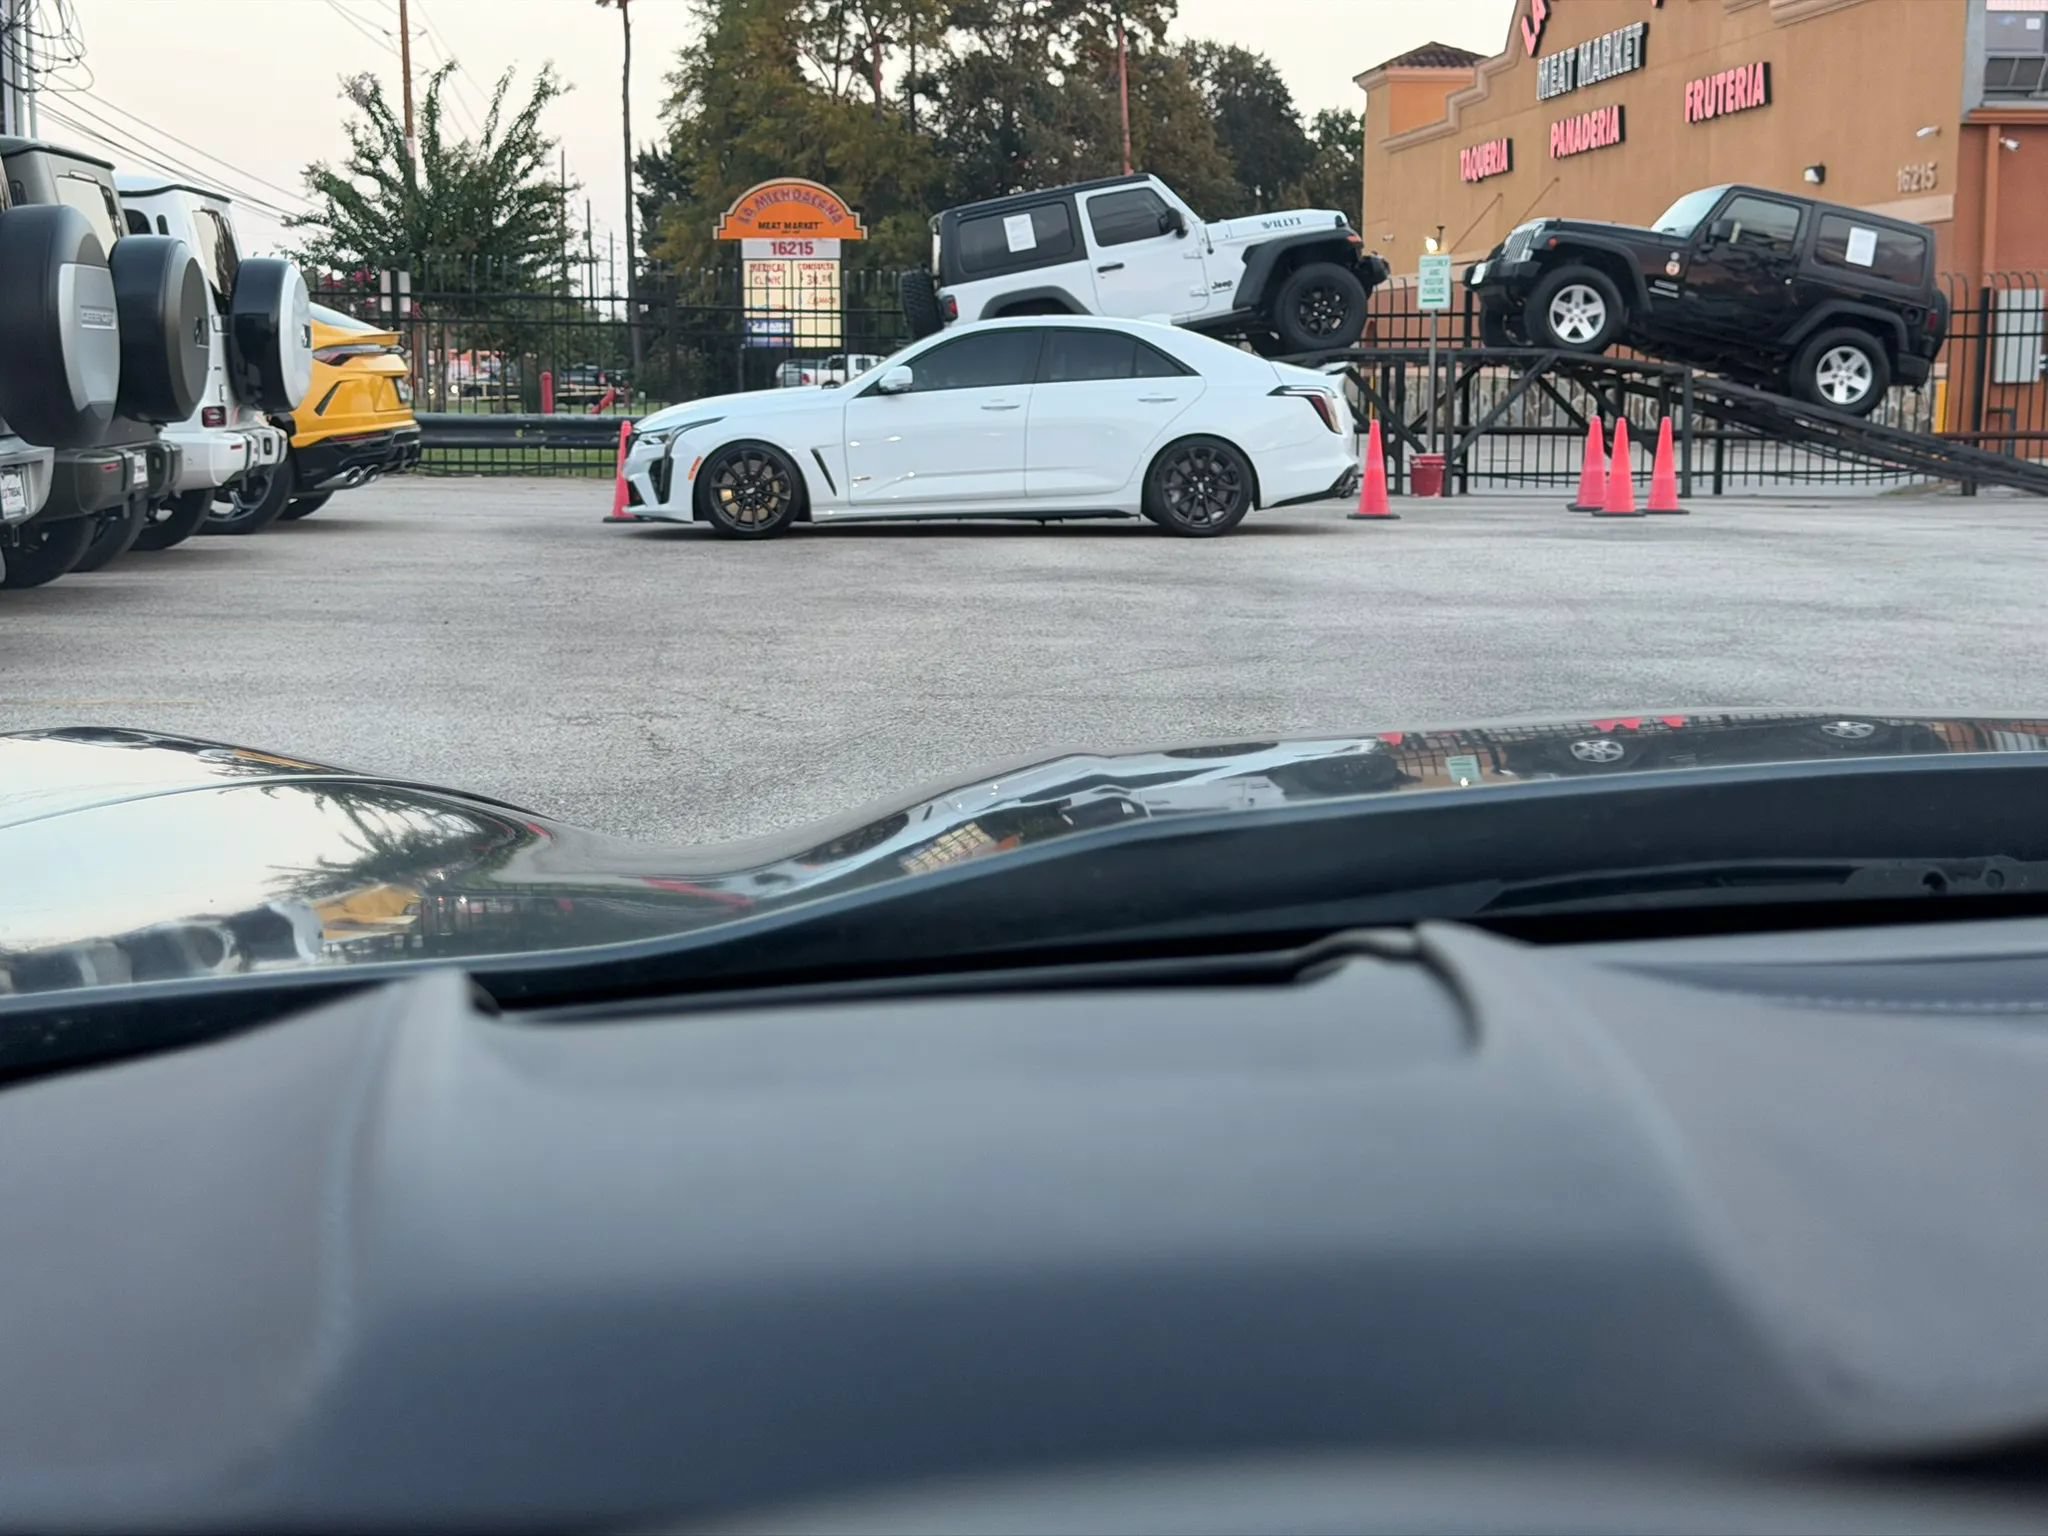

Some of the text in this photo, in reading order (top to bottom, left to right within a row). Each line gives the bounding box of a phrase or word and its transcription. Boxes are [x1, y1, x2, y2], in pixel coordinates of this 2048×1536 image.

[1536, 21, 1645, 101] MEAT MARKET
[1684, 62, 1768, 123] FRUTERIA
[1550, 105, 1622, 159] PANADERIA
[1460, 138, 1510, 182] TAQUERIA
[1896, 161, 1937, 192] 16215
[758, 221, 819, 230] MEAT MARKET
[770, 241, 814, 256] 16215
